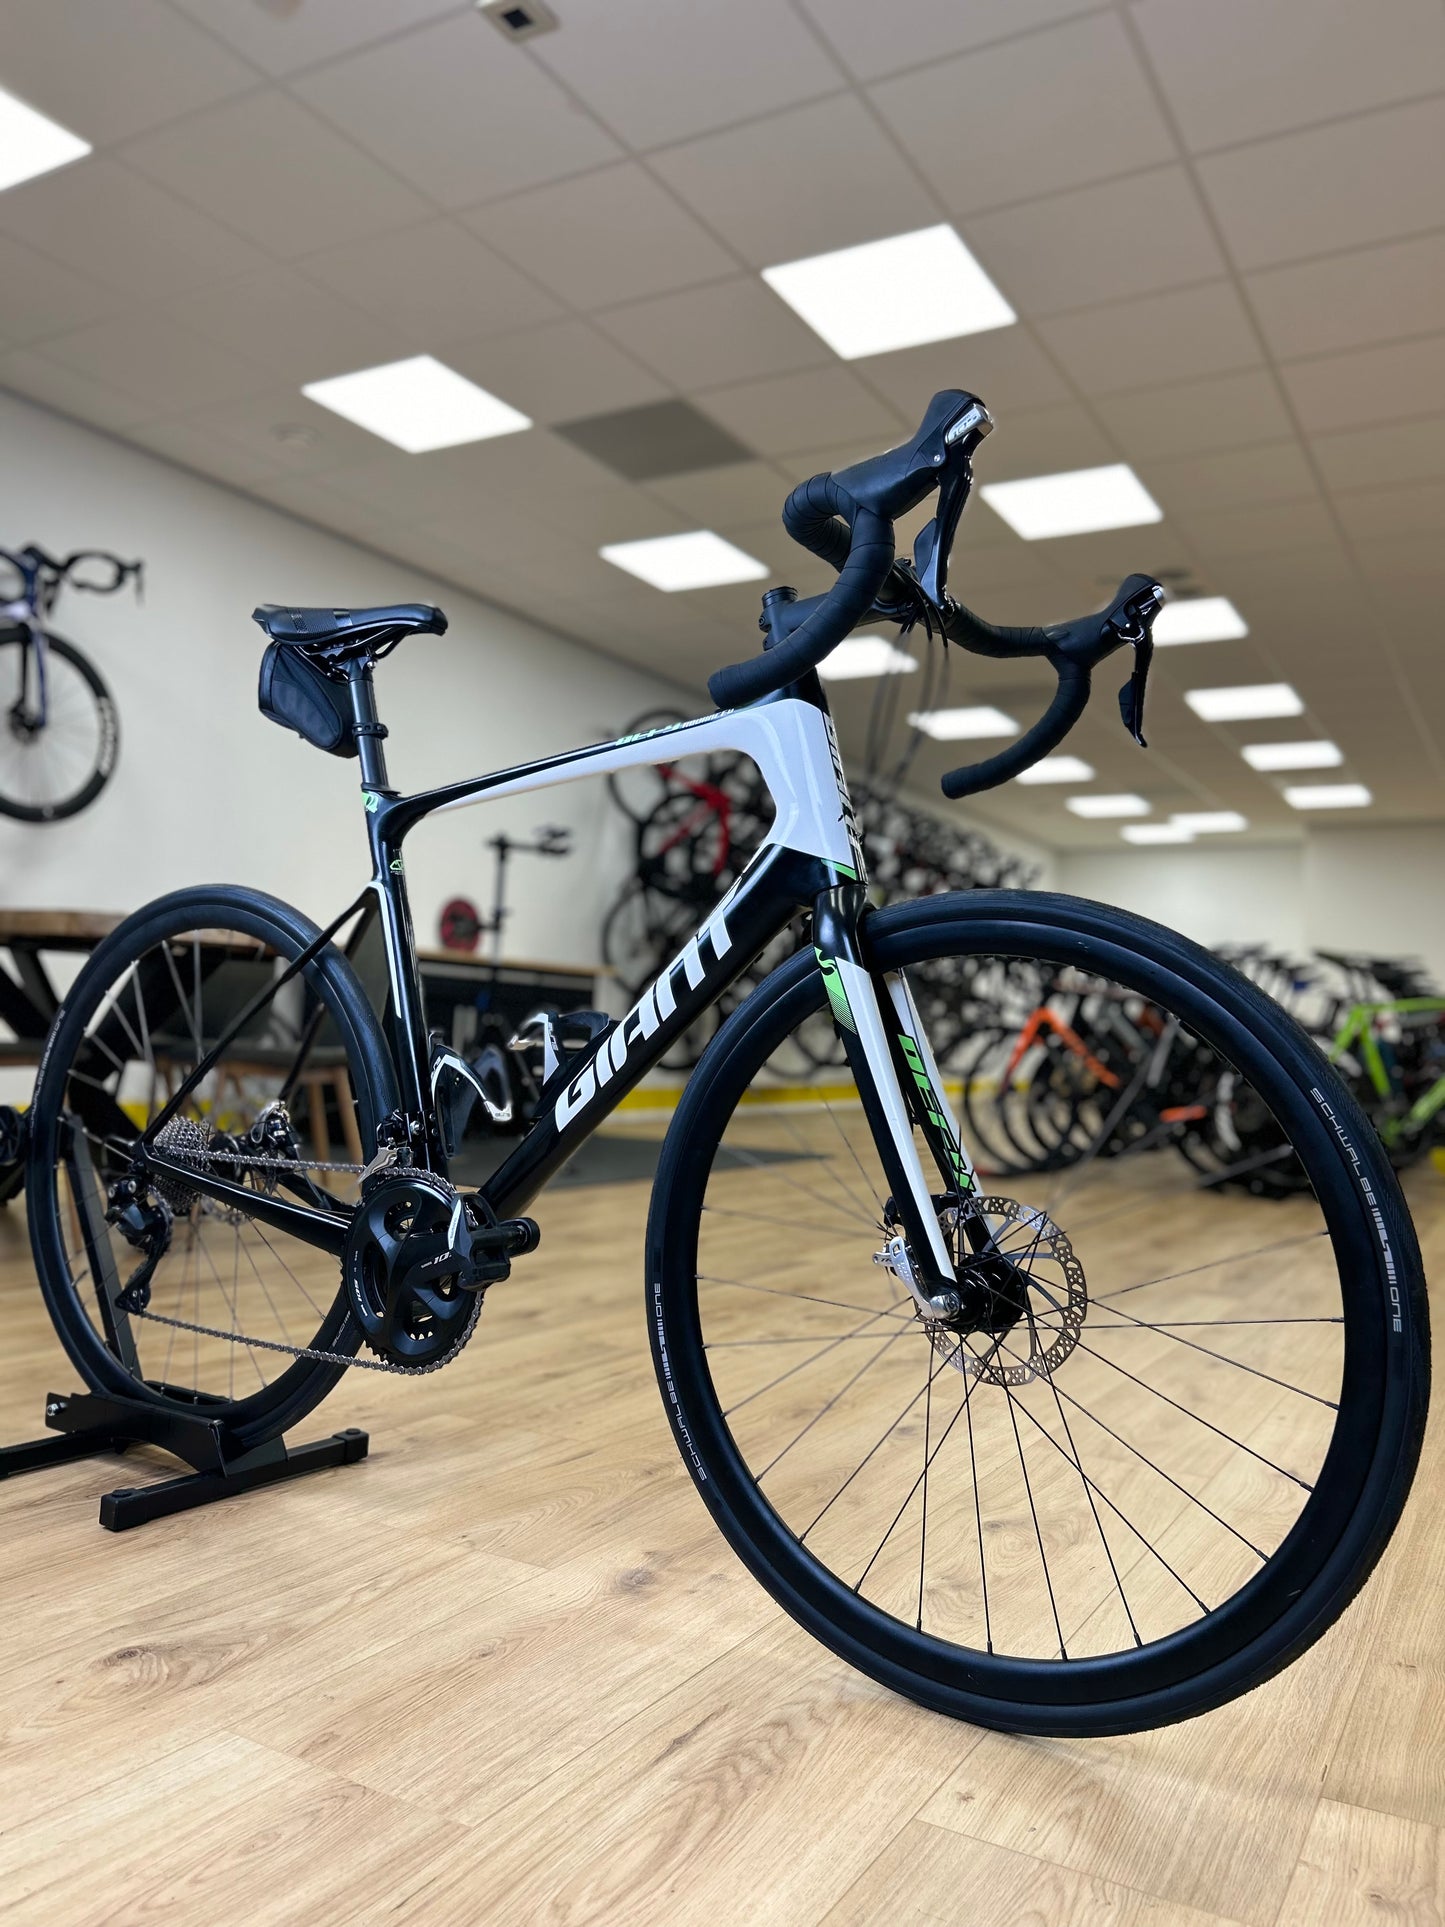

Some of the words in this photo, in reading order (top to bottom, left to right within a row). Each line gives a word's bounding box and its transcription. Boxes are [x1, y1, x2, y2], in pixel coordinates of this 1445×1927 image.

[555, 876, 743, 1132] GIANT
[434, 1251, 452, 1265] 10
[1309, 1087, 1377, 1206] SCHWALBE
[1390, 1286, 1402, 1333] ONE
[654, 1282, 664, 1318] ONE
[666, 1380, 708, 1481] SCHWALBE
